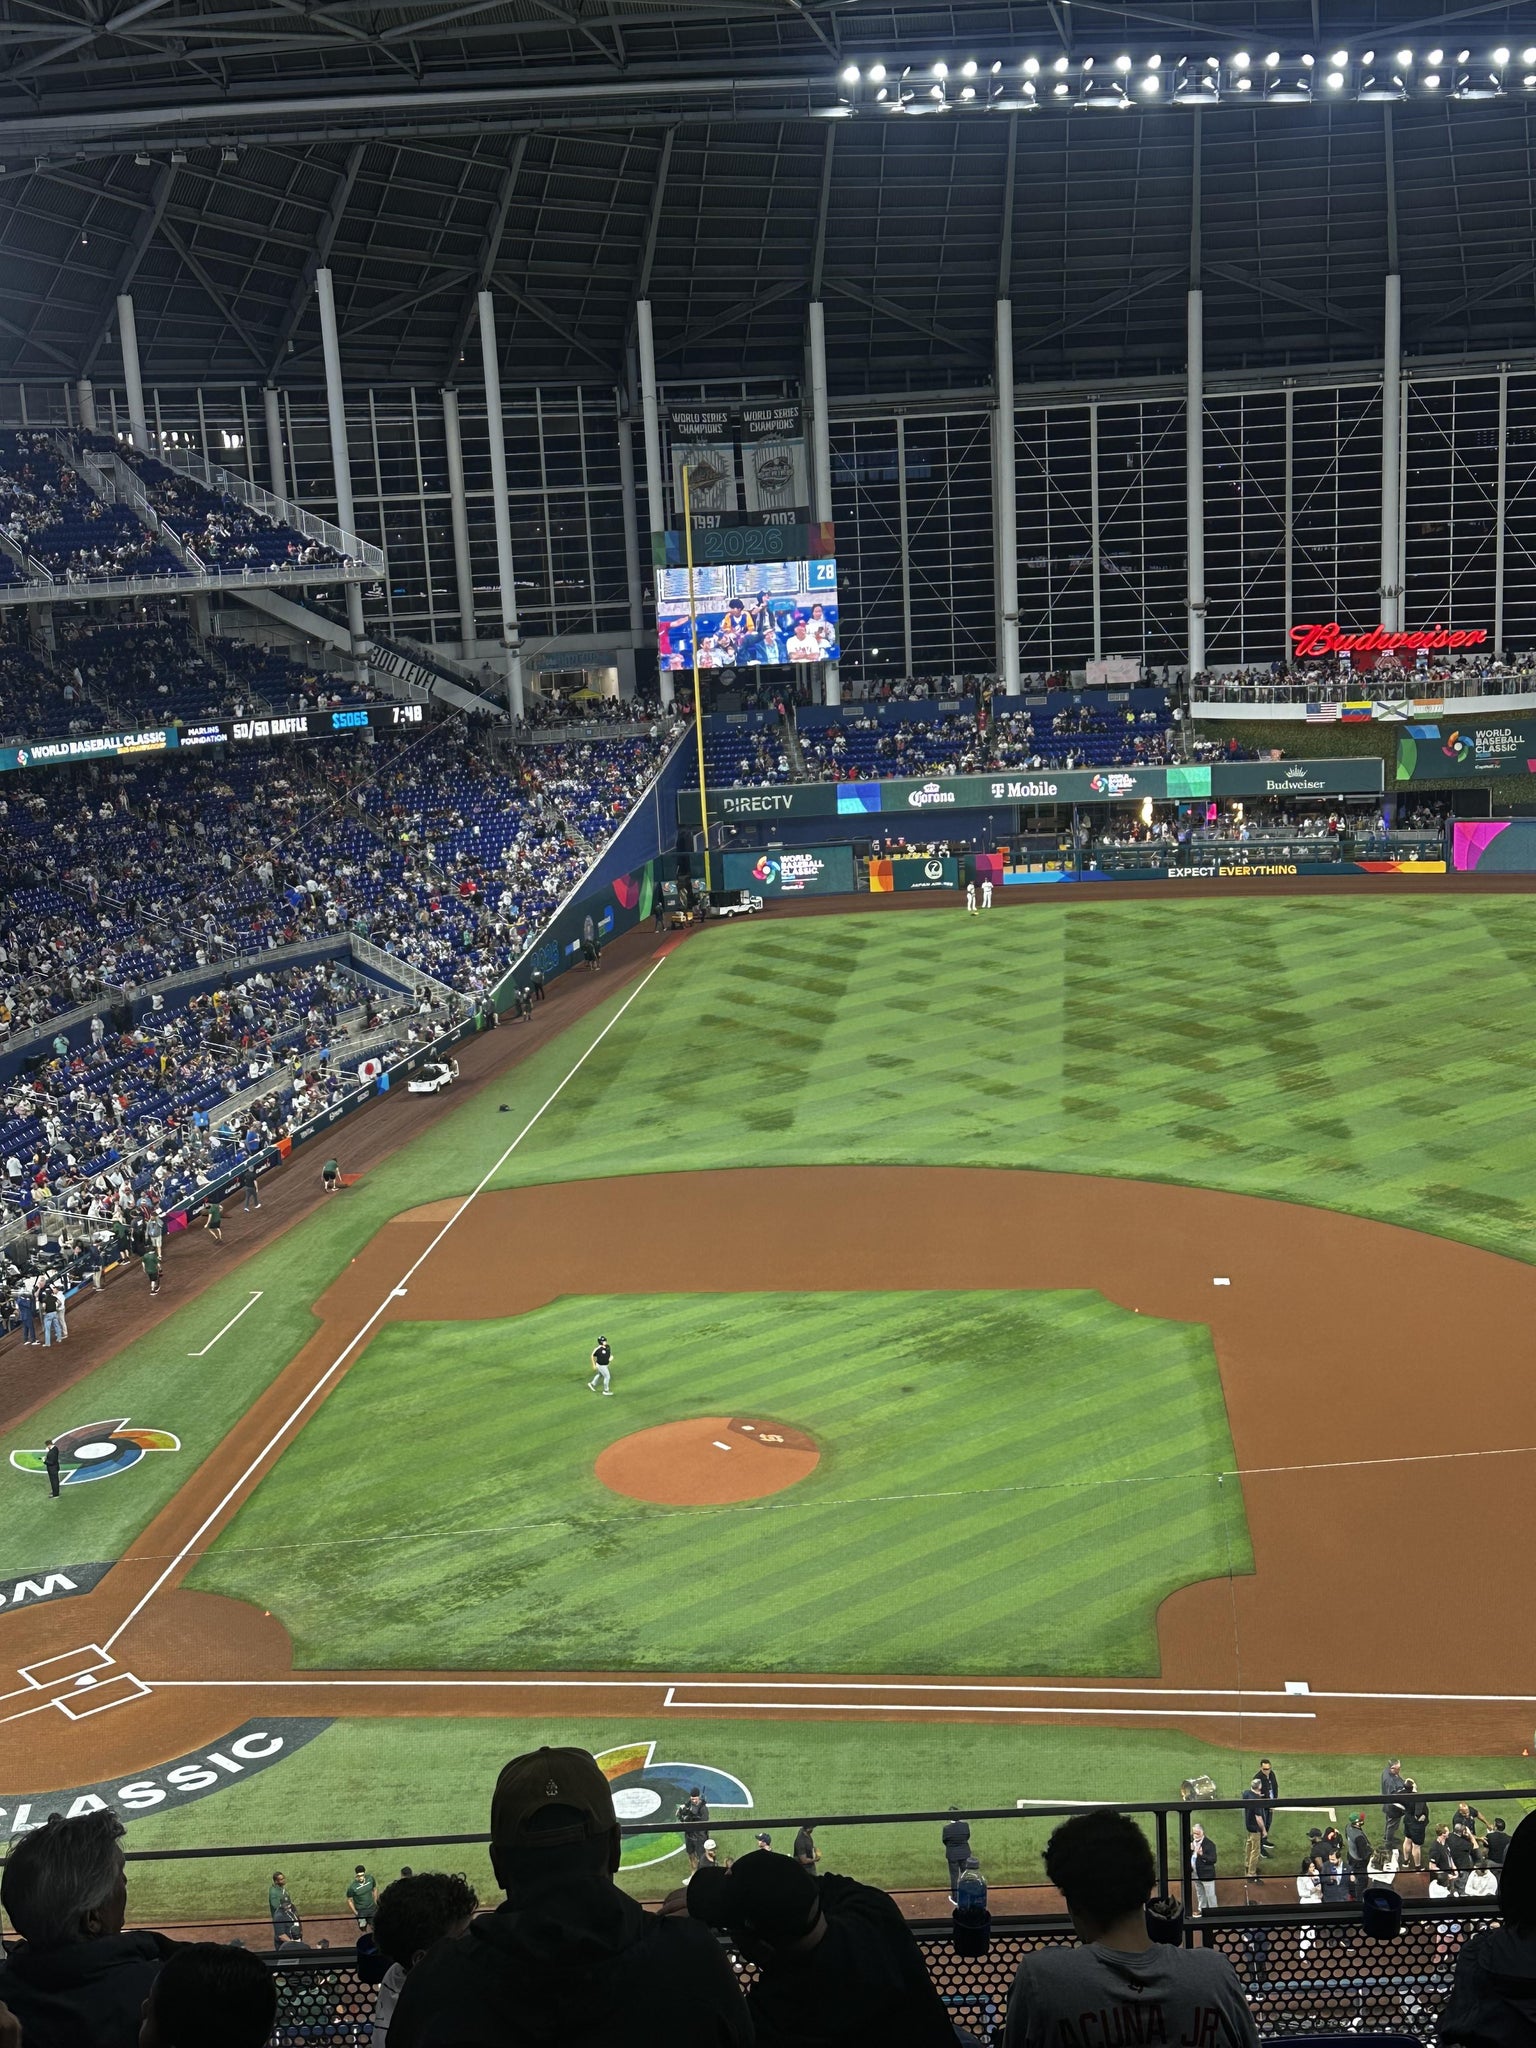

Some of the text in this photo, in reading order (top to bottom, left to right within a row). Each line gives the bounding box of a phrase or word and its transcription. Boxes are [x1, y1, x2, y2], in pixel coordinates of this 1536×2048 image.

[672, 412, 728, 423] WORLD SERIES
[744, 407, 799, 421] WORLD SERIES
[678, 423, 723, 434] CHAMPIONS
[749, 419, 794, 432] CHAMPIONS
[692, 515, 721, 529] 1997
[762, 511, 796, 525] 2003
[705, 529, 783, 557] 2026
[816, 564, 835, 581] 28
[1288, 622, 1488, 657] Budweiser
[370, 645, 437, 694] 300 LEVEL
[332, 711, 368, 729] $5065
[392, 704, 422, 723] 7:48
[188, 725, 219, 736] MARLINS
[233, 717, 308, 740] 50/50 RAFFLE
[1475, 728, 1512, 738] WORLD
[31, 744, 70, 759] WORLD
[70, 736, 123, 754] BASEBALL
[123, 731, 166, 746] CLASSIC
[181, 734, 228, 746] FOUNDATION
[1475, 735, 1525, 746] BASEBALL
[1475, 743, 1517, 753] CLASSIC
[1007, 781, 1058, 798] Mobile
[1266, 780, 1326, 790] Budweiser
[723, 794, 793, 813] DIRECTV
[908, 789, 955, 807] Corona
[780, 854, 812, 862] WORLD
[781, 860, 824, 869] BASEBALL
[1168, 864, 1297, 878] EXPECT EVERYTHING
[0, 1732, 284, 1833] LASSIC
